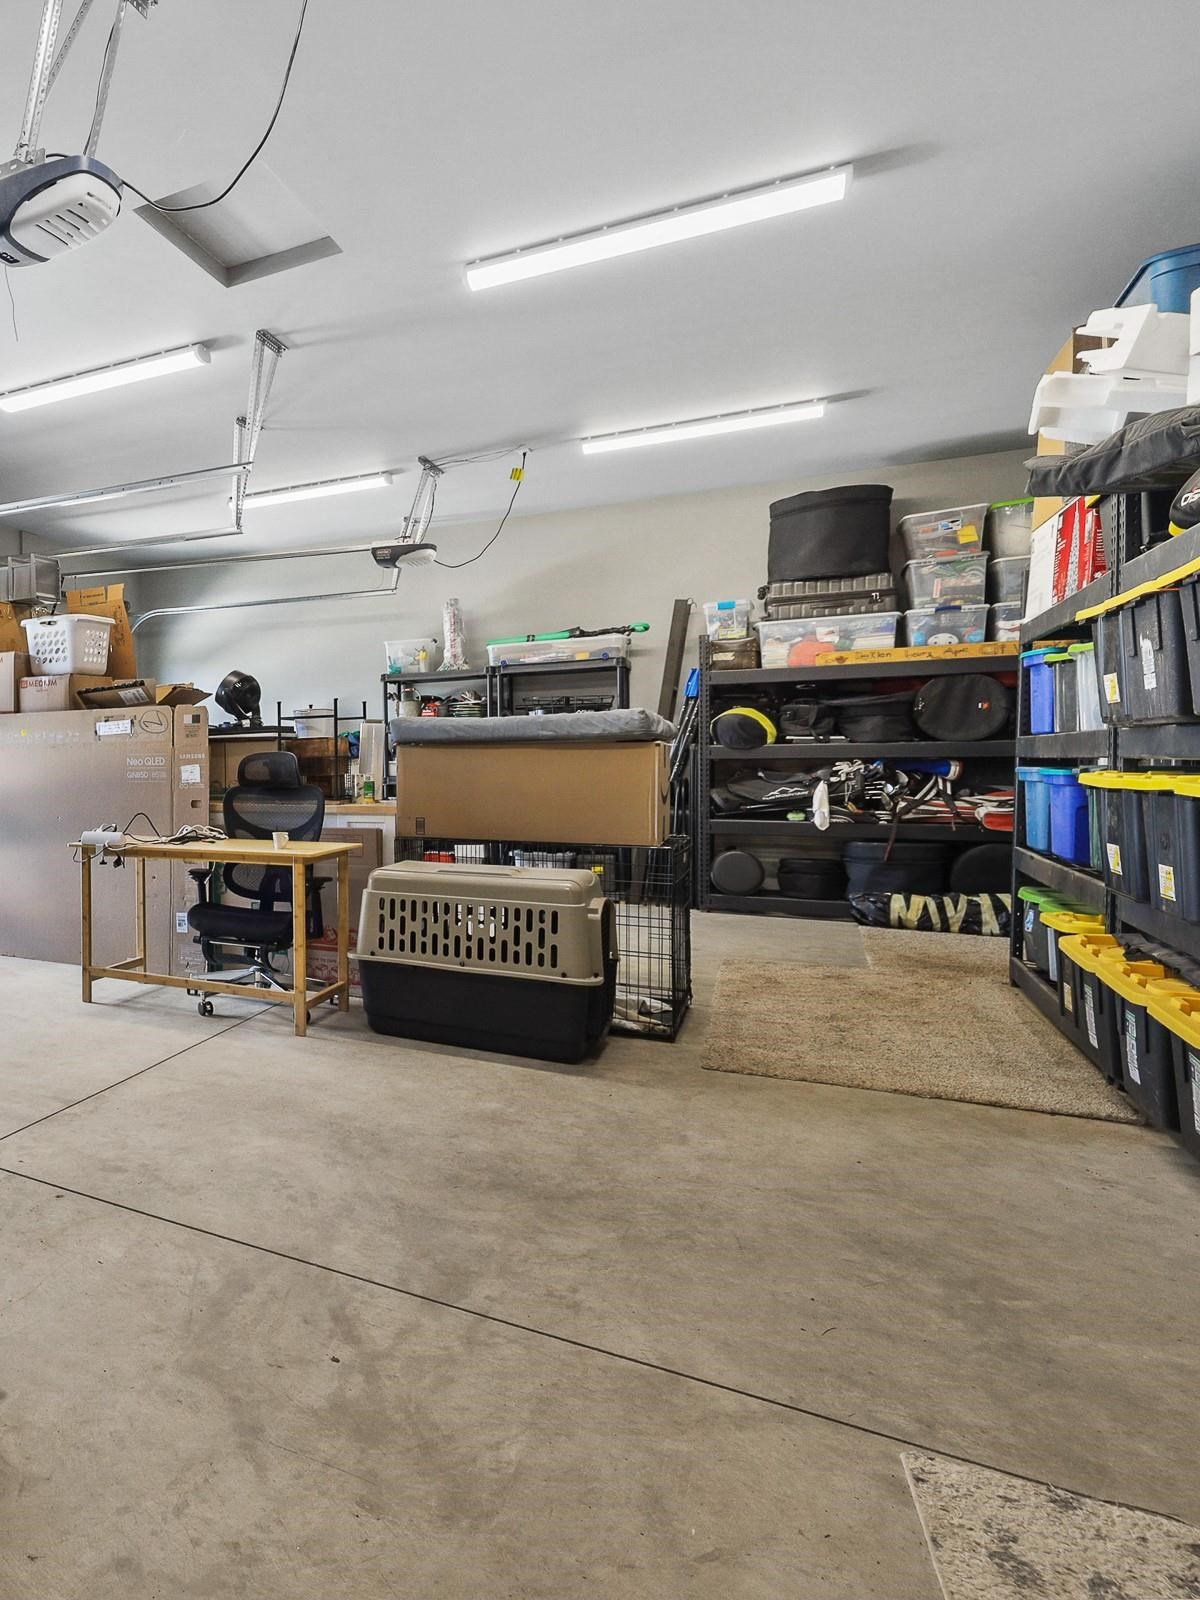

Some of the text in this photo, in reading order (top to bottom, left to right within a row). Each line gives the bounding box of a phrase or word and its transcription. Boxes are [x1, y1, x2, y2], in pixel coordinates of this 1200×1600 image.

[28, 679, 57, 687] MEDIUM
[126, 757, 166, 766] Neo QLED
